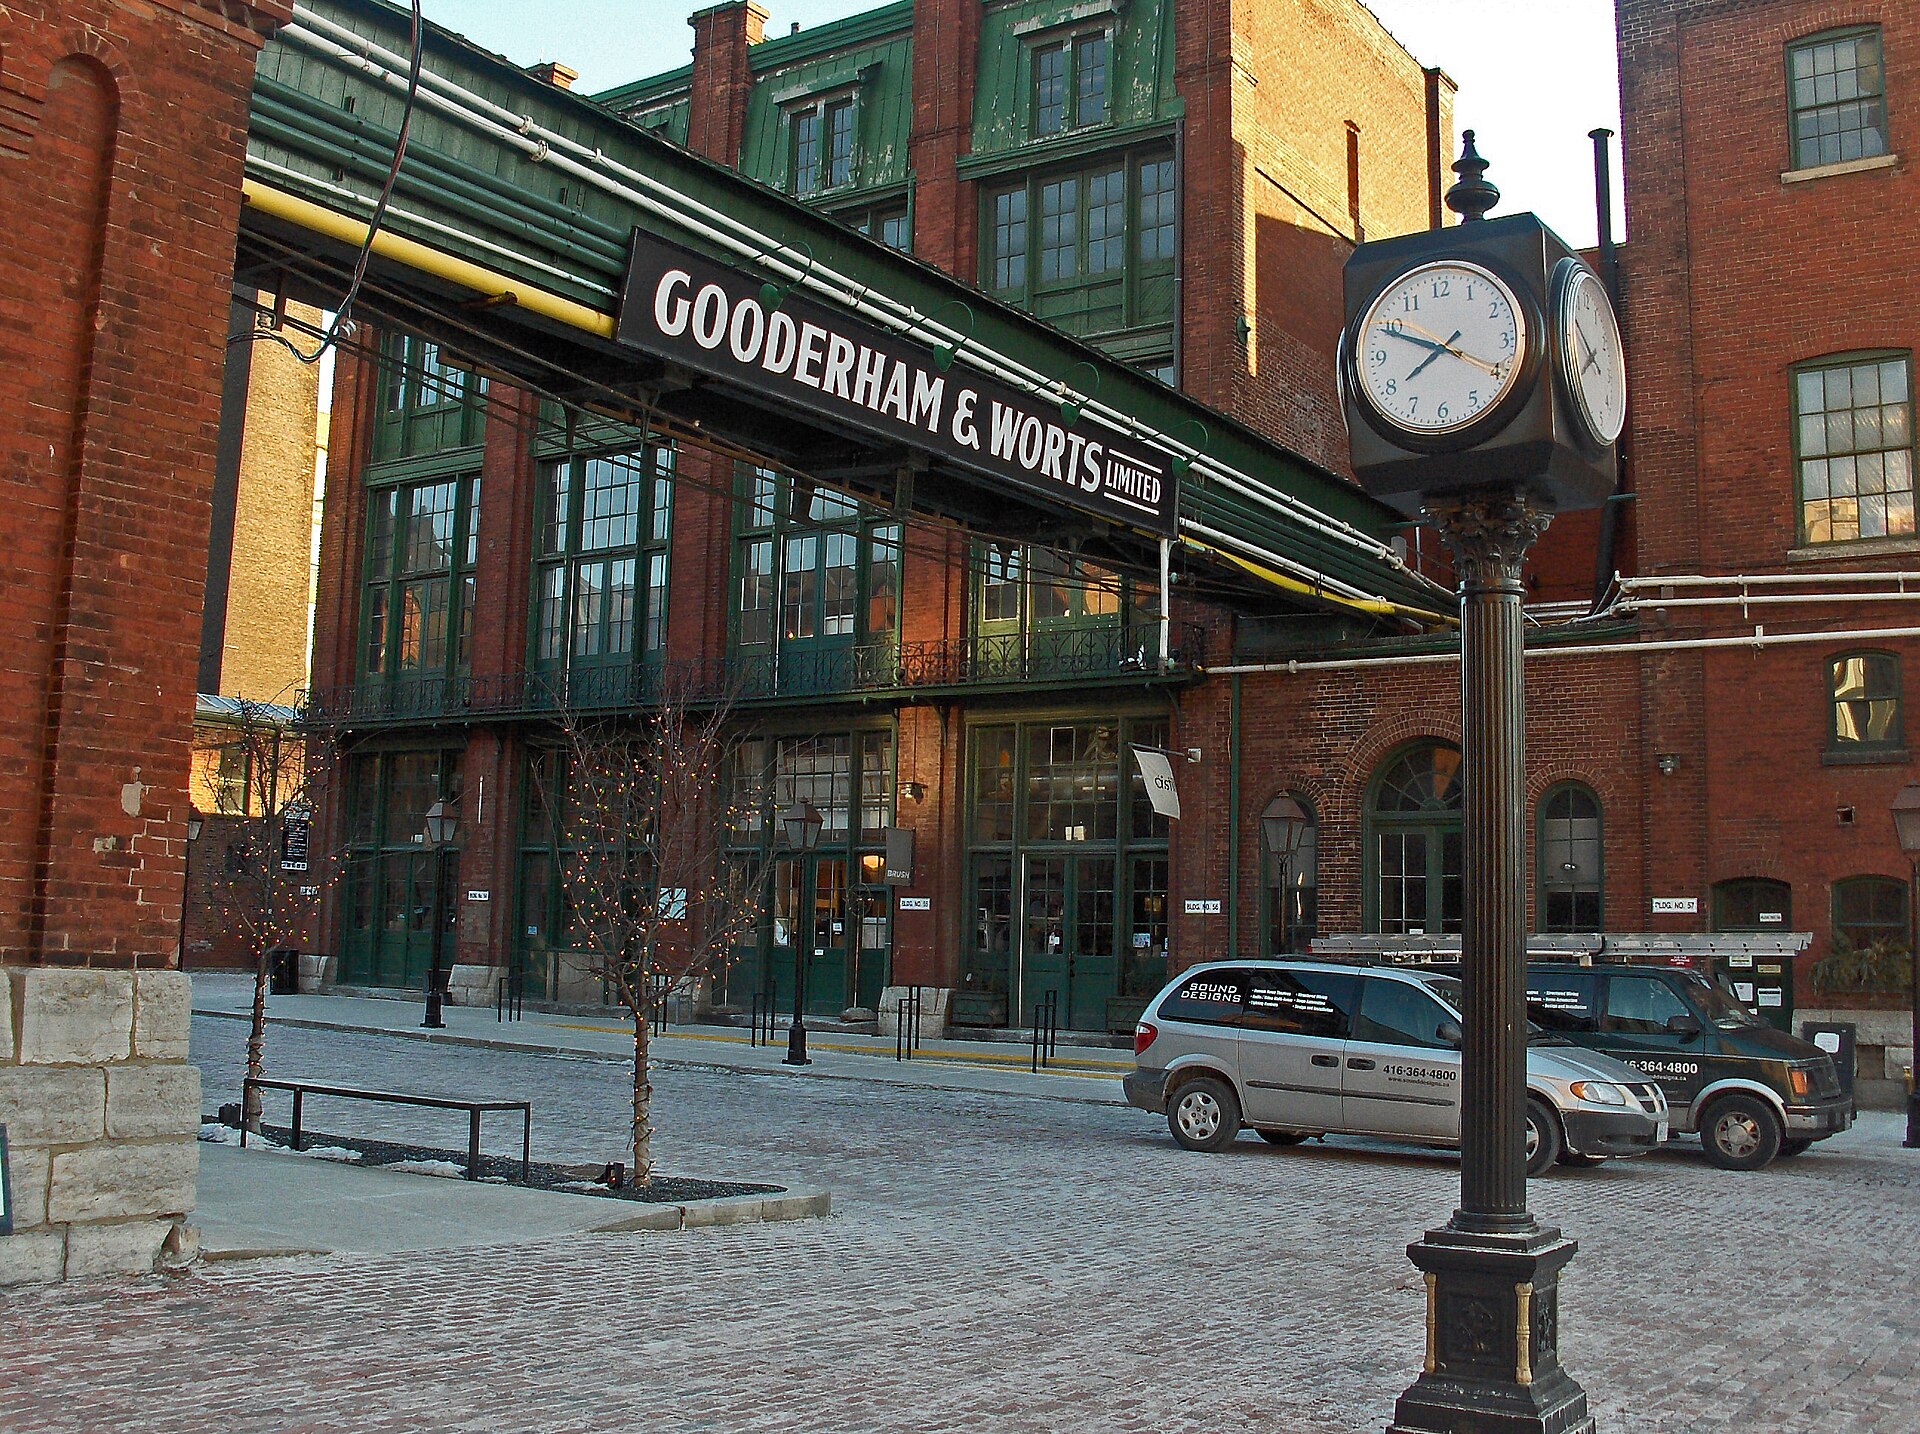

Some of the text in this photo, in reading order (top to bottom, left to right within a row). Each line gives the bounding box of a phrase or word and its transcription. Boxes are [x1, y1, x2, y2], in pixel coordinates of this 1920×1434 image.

[1431, 280, 1450, 298] 12
[1466, 284, 1474, 301] 1
[1402, 294, 1420, 312] 11
[1488, 302, 1499, 318] 2
[1385, 318, 1403, 333] 10
[1499, 332, 1509, 349] 3
[1375, 350, 1386, 367] 9
[1491, 362, 1501, 380] 4
[654, 270, 1103, 493] GOODERHAM & WORTS
[1385, 379, 1396, 396] 8
[1409, 396, 1418, 414] 7
[1468, 390, 1478, 407] 5
[1437, 401, 1449, 418] 6
[1105, 459, 1162, 504] LIMITED
[887, 869, 910, 879] BRUSH
[1687, 901, 1695, 909] 57
[1181, 991, 1242, 1003] DESIGNS
[1190, 983, 1238, 994] SOUND
